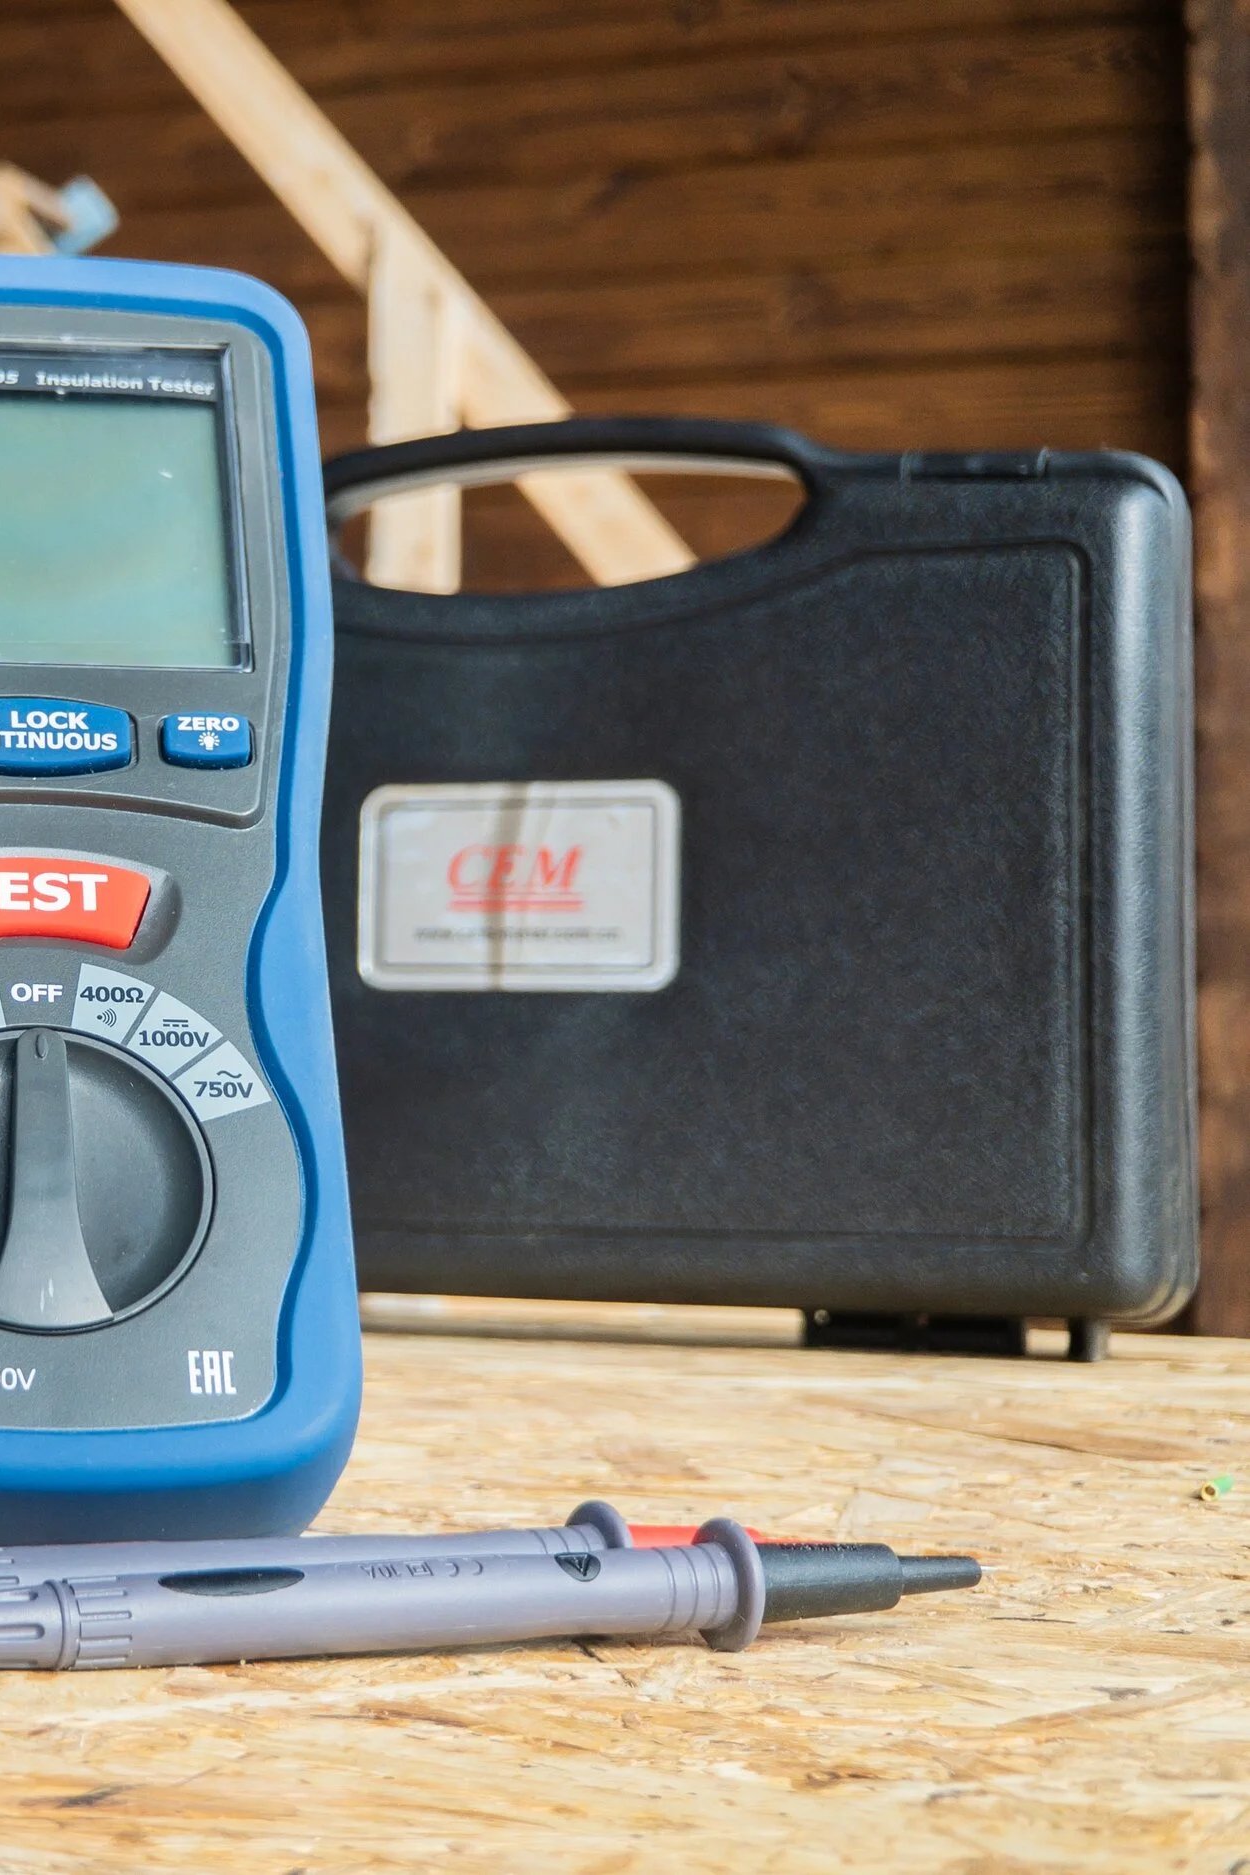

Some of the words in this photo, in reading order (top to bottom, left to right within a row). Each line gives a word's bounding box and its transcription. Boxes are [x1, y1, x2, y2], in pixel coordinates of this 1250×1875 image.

[35, 371, 144, 391] Insulation
[148, 376, 216, 397] Tester
[11, 711, 88, 730] LOCK
[177, 716, 240, 732] ZERO
[445, 844, 587, 891] CEM
[10, 983, 63, 1003] OFF
[79, 985, 145, 1004] 400Ω
[138, 1029, 211, 1049] 1000V
[193, 1080, 254, 1099] 750V
